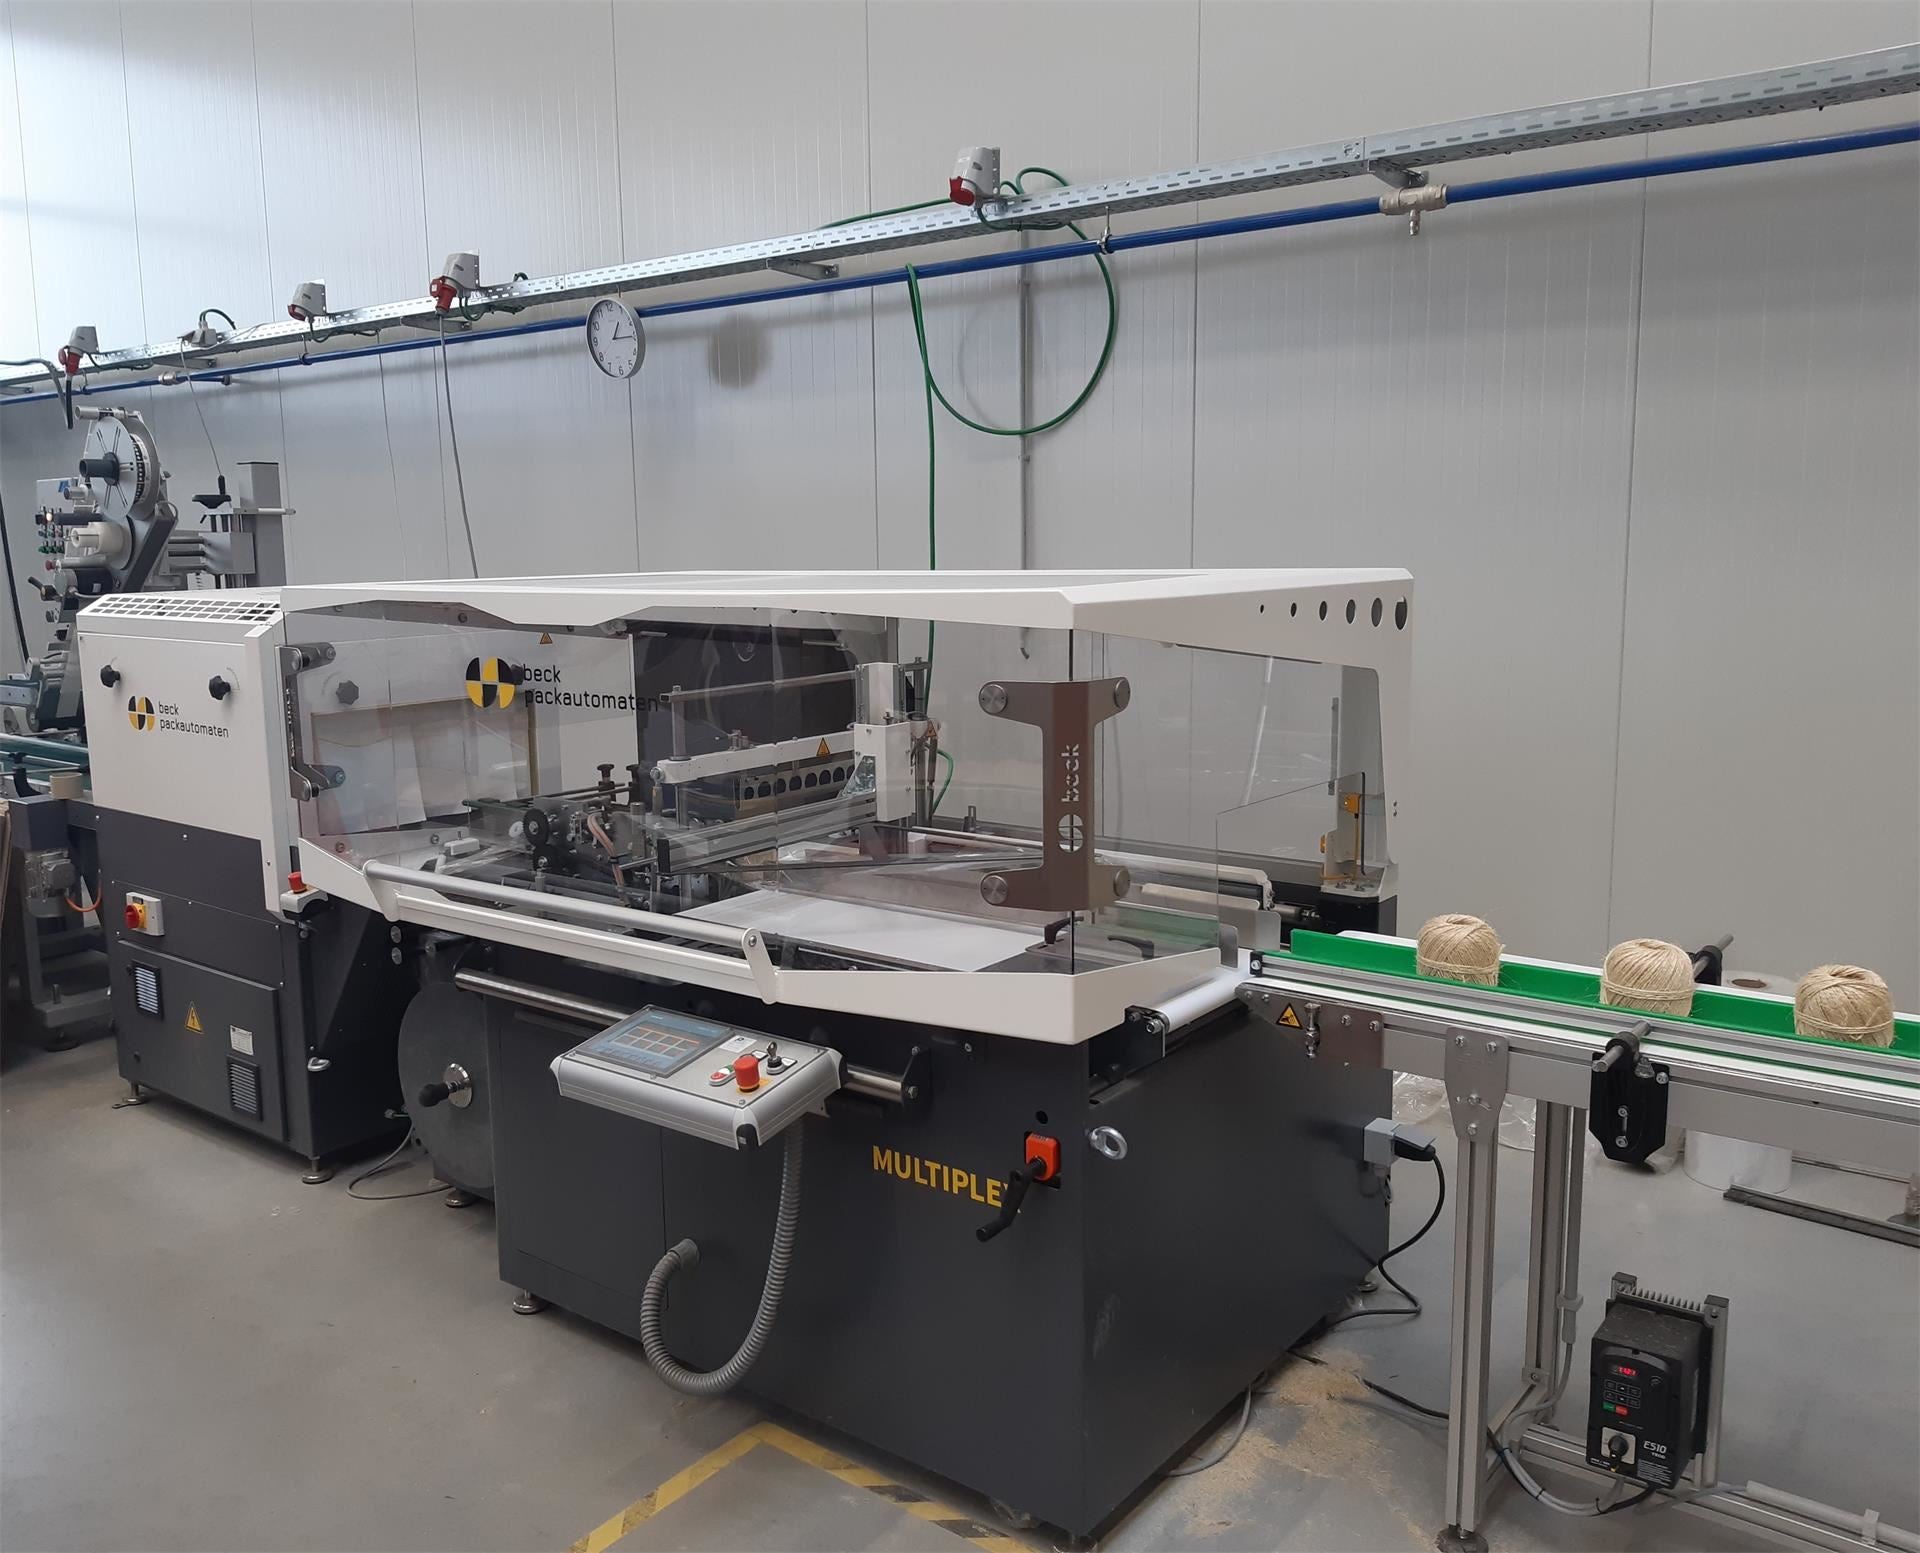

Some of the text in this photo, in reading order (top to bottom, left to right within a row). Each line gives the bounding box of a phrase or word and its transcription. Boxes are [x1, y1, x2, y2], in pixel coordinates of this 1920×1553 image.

[596, 308, 603, 319] 11
[605, 303, 614, 312] 12
[592, 321, 600, 331] 10
[592, 337, 599, 347] 9
[598, 352, 605, 362] 8
[607, 362, 612, 373] 7
[618, 365, 624, 376] 6
[523, 664, 561, 683] beck
[525, 688, 658, 712] packautomaten
[159, 701, 179, 716] beck
[159, 718, 229, 738] packautomaten
[1061, 743, 1079, 802] beck
[873, 1145, 1021, 1214] MULTIPLE
[1643, 1440, 1667, 1454] ES10
